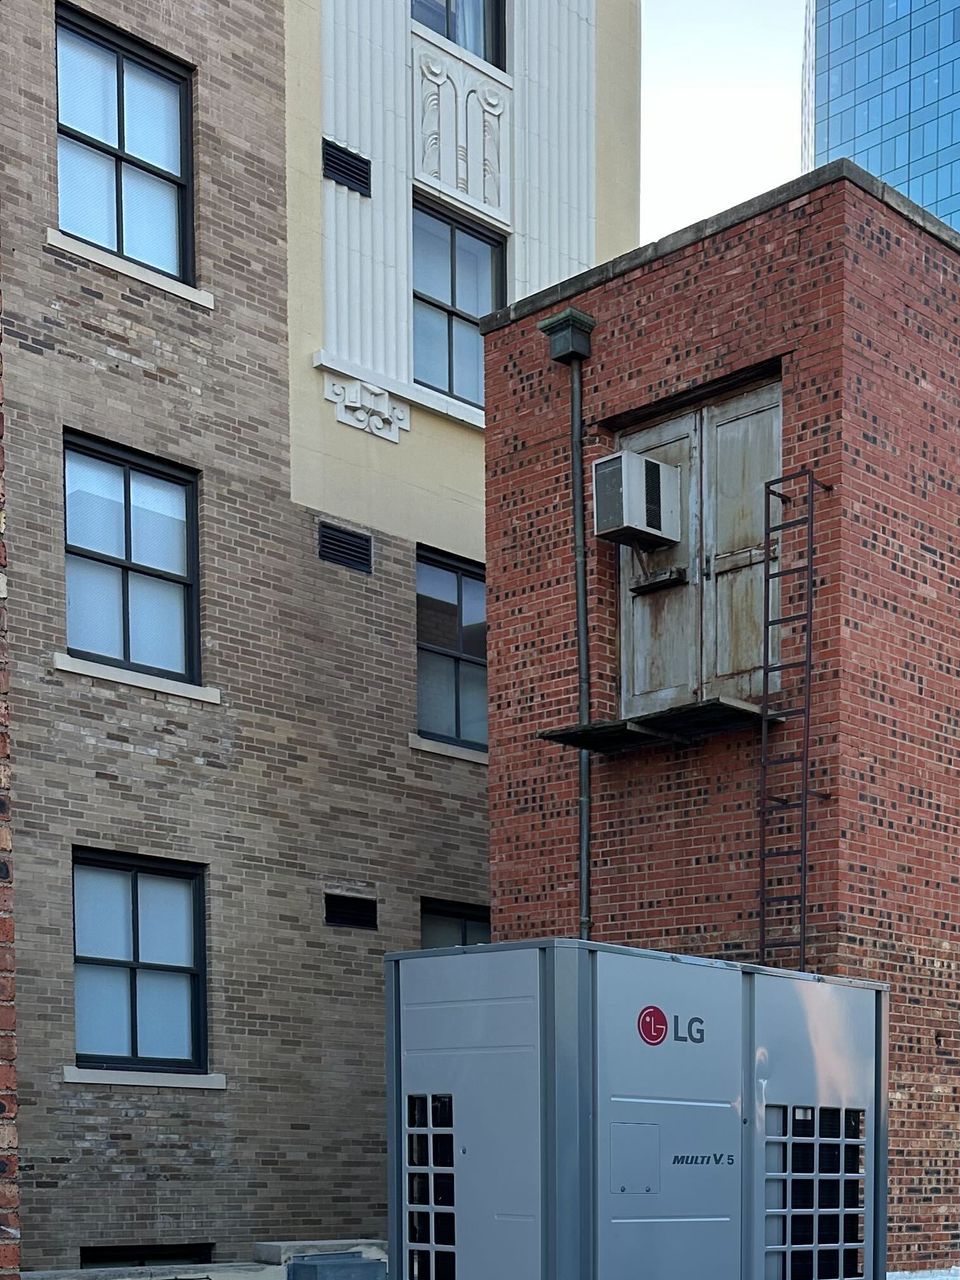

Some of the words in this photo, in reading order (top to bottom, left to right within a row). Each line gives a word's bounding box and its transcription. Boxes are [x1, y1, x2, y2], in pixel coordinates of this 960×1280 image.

[673, 1015, 705, 1044] LG
[672, 1155, 711, 1165] MULTI
[727, 1154, 735, 1166] 5
